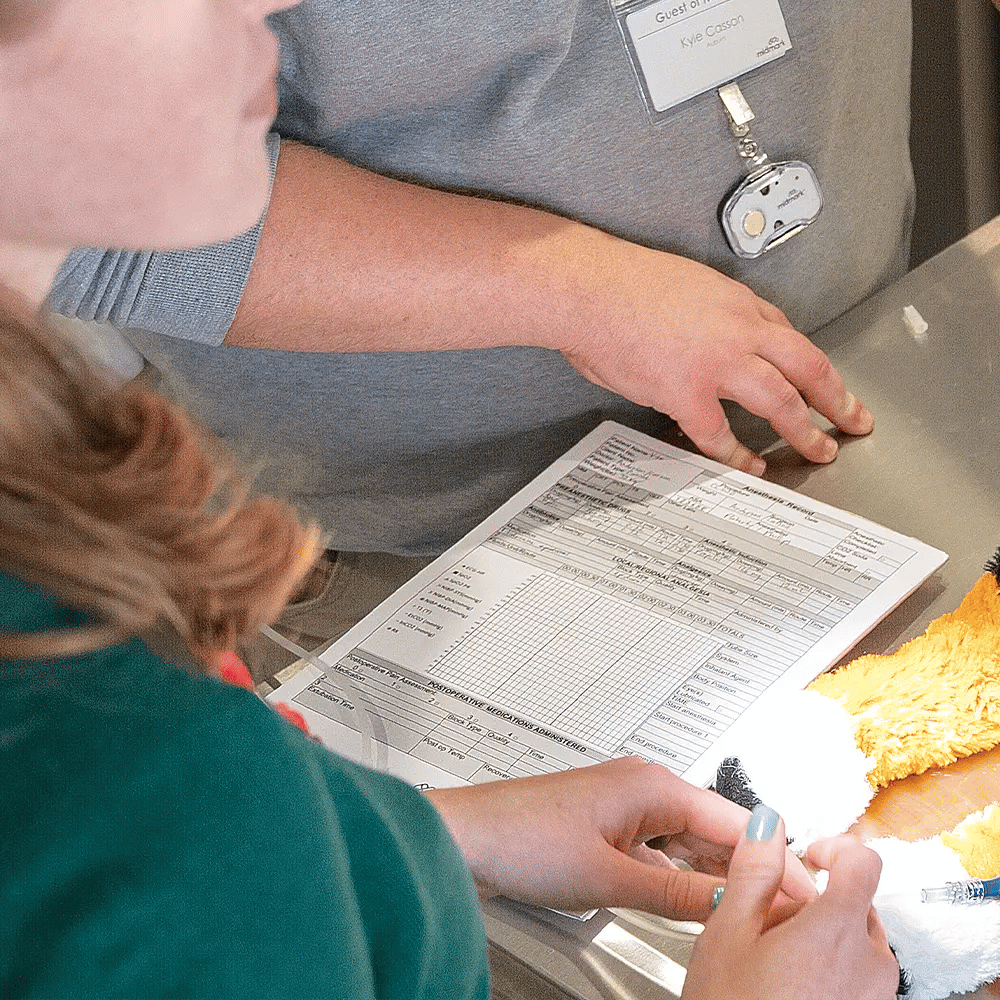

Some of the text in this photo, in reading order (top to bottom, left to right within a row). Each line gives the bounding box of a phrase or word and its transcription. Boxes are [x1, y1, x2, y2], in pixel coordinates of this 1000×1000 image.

[655, 2, 688, 24] Guest
[680, 14, 745, 49] Kyle Casson
[756, 40, 787, 58] midmark
[777, 188, 806, 210] midmark
[741, 485, 785, 504] Anesthesia
[785, 502, 815, 516] Record
[676, 561, 712, 578] Analgesics
[653, 579, 677, 591] Quality
[733, 610, 774, 629] Administered
[716, 625, 745, 639] TOTALS
[714, 653, 740, 666] System
[727, 643, 759, 658] Tube Size
[332, 664, 367, 681] Medication
[345, 653, 386, 674] Postoperative
[384, 670, 401, 680] Pain
[704, 663, 750, 685] Inhalant Agent
[681, 684, 704, 696] Eye(s)
[692, 674, 737, 694] Body Position
[306, 686, 356, 710] Extubation Time
[670, 695, 689, 705] TIME
[676, 689, 711, 707] Lubricated
[426, 680, 588, 753] POSTOPERATIVE MEDICATIONS ADMINISTERED
[665, 701, 717, 725] Start anesthesia
[446, 714, 483, 733] Block Type
[653, 712, 671, 721] Start
[668, 719, 703, 737] procedure
[486, 731, 512, 745] Quality
[629, 735, 678, 759] End procedure
[422, 737, 439, 747] Post
[446, 748, 467, 760] Temp
[528, 749, 546, 760] Time
